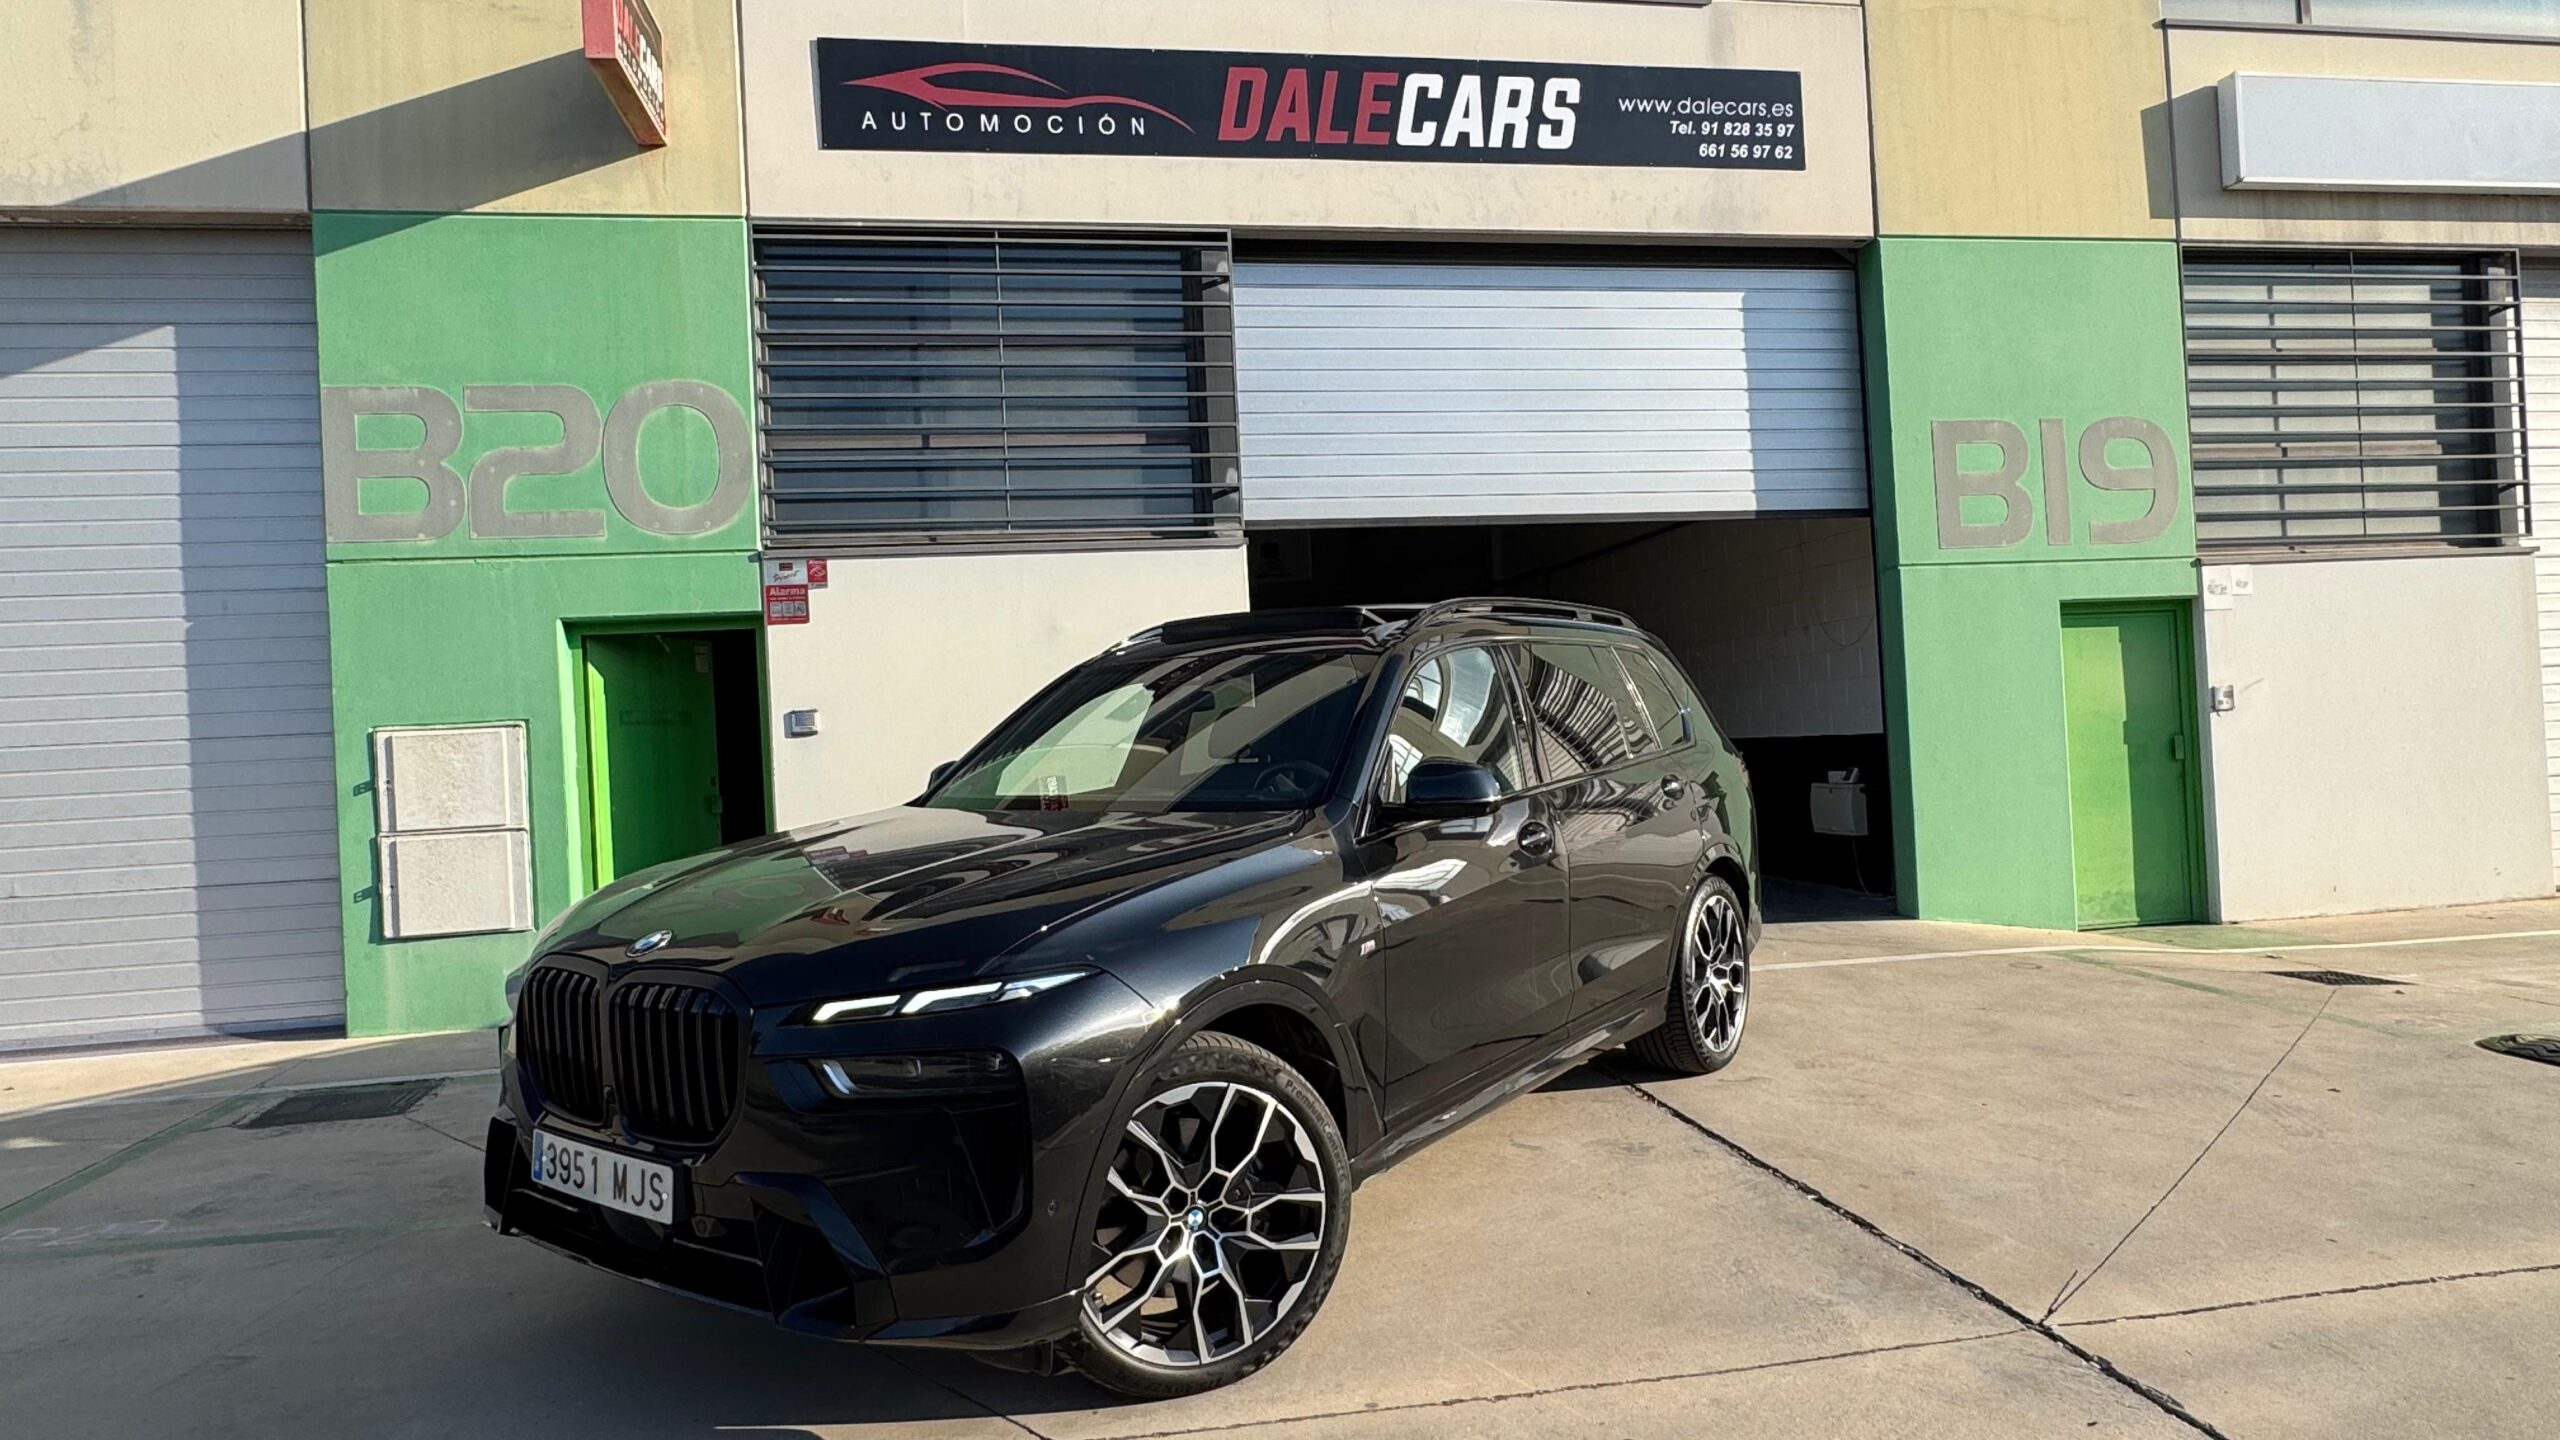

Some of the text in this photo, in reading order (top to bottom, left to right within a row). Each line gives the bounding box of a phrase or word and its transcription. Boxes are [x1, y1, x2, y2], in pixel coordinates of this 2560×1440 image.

[861, 111, 1145, 136] AUTOMOCIÓN
[1217, 66, 1581, 150] DALECARS
[1618, 97, 1794, 117] www.dalecars.es
[1669, 120, 1795, 138] Tel. 91 828 35 97
[1699, 143, 1793, 159] 661 56 97 62
[321, 379, 754, 543] B20
[1930, 416, 2180, 549] B19
[546, 1142, 664, 1212] 3951 MJS
